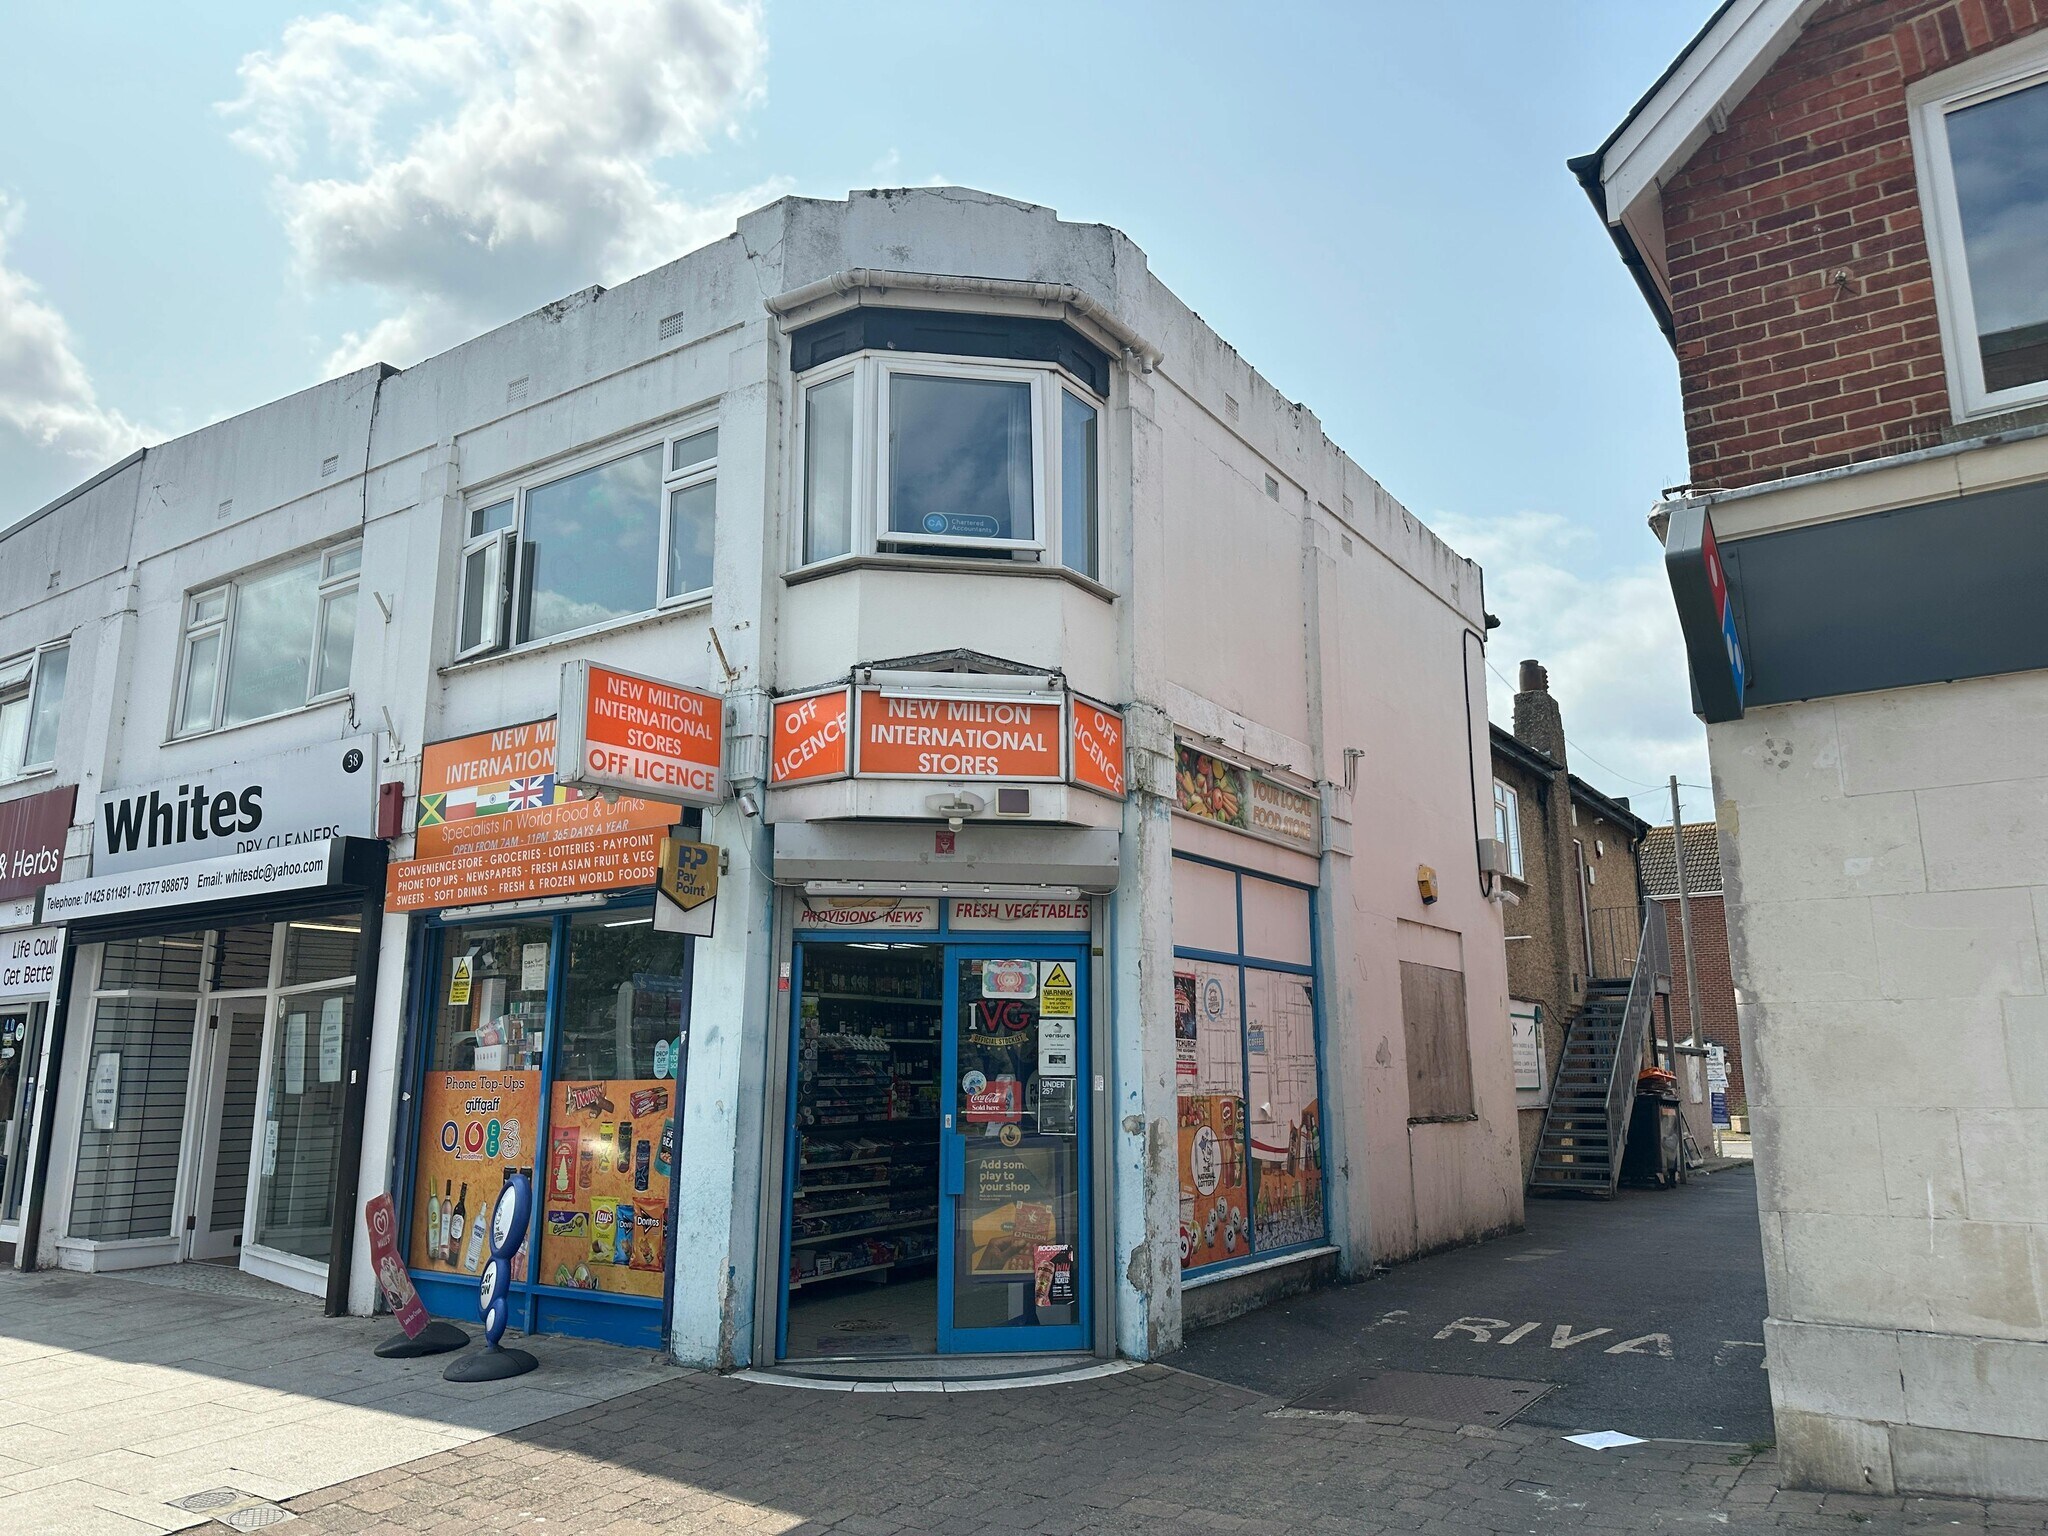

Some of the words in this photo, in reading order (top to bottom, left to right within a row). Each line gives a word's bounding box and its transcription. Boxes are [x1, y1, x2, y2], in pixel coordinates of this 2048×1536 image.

[927, 519, 943, 527] CA
[951, 518, 984, 527] Chartered
[951, 524, 993, 533] Accountants
[607, 676, 644, 701] NEW
[648, 687, 703, 716] MILTON
[594, 697, 713, 741] INTERNATIONAL
[785, 697, 818, 735] OFF
[888, 698, 940, 720] NEW
[947, 701, 1031, 725] MILTON
[491, 725, 530, 752] NEW
[871, 723, 1048, 752] INTERNATIONAL
[1094, 711, 1118, 746] OFF
[627, 728, 682, 755] STORES
[773, 711, 847, 781] LICENCE
[347, 753, 359, 768] 38
[445, 745, 556, 785] INTERNATION
[918, 752, 999, 775] STORES
[1073, 716, 1123, 793] LICENCE
[589, 748, 629, 775] OFF
[634, 757, 715, 792] LICENCE
[1252, 779, 1280, 805] YOUR
[1280, 788, 1312, 818] LOCAL
[104, 783, 263, 855] Whites
[441, 821, 500, 844] Specialists
[502, 817, 513, 831] In
[516, 811, 552, 829] World
[556, 803, 589, 823] Food
[593, 801, 602, 818] &
[606, 798, 646, 816] Drinks
[1253, 805, 1281, 832] FOOD
[1282, 814, 1312, 841] STORE
[452, 843, 474, 856] OPEN
[475, 840, 499, 852] FROM
[500, 836, 519, 848] 7AM
[527, 831, 549, 845] 11PM
[552, 828, 568, 841] 365
[570, 823, 594, 838] DAYS
[595, 822, 602, 833] A
[606, 819, 629, 833] YEAR
[12, 845, 60, 879] Herbs
[397, 861, 456, 878] CONVENIENCE
[457, 856, 483, 870] STORE
[490, 848, 541, 865] GROCERIES
[548, 841, 595, 858] LOTTERIES
[603, 833, 654, 851] PAYPOINT
[397, 880, 424, 892] PHONE
[426, 877, 441, 888] TOP
[443, 874, 458, 886] UPS
[466, 865, 522, 883] NEWSPAPERS
[531, 859, 558, 875] FRESH
[560, 855, 593, 871] ASIAN
[594, 851, 621, 868] FRUIT
[622, 852, 630, 864] &
[633, 850, 655, 863] VEG
[677, 868, 697, 885] Pay
[47, 895, 83, 912] Telephone:
[84, 888, 106, 905] 01425
[106, 885, 131, 901] 611491
[137, 880, 160, 897] 07377
[161, 876, 190, 894] 988679
[197, 871, 223, 888] Email:
[225, 859, 324, 884] whitesdc@yahoo.com
[396, 892, 425, 906] SWEETS
[434, 889, 454, 901] SOFT
[457, 884, 488, 899] DRINKS
[499, 880, 525, 894] FRESH
[528, 879, 536, 890] &
[539, 872, 576, 889] FROZEN
[579, 869, 615, 885] WORLD
[618, 865, 655, 880] FOODS
[676, 881, 706, 896] Point
[801, 910, 877, 923] PROVISIONS
[885, 911, 924, 923] NEWS
[956, 903, 999, 918] FRESH
[1005, 903, 1089, 919] VEGETABLES
[12, 939, 30, 959] Life
[33, 936, 58, 956] Coul
[3, 967, 21, 986] Get
[1043, 989, 1073, 997] WARNING
[968, 1000, 1030, 1032] IVG
[445, 1076, 477, 1090] Phone
[479, 1075, 525, 1092] Top-Ups
[1041, 1080, 1066, 1088] UNDER
[465, 1097, 501, 1115] giffgaff
[980, 1160, 1001, 1169] Add
[980, 1171, 1002, 1182] play
[1004, 1171, 1015, 1180] to
[980, 1183, 1004, 1193] your
[1005, 1181, 1031, 1193] shop
[596, 1209, 613, 1224] Lay's
[637, 1216, 660, 1227] Doritos
[1021, 1232, 1047, 1241] MILLION
[1037, 1244, 1069, 1252] ROCKSTAR
[1056, 1263, 1071, 1271] WIN
